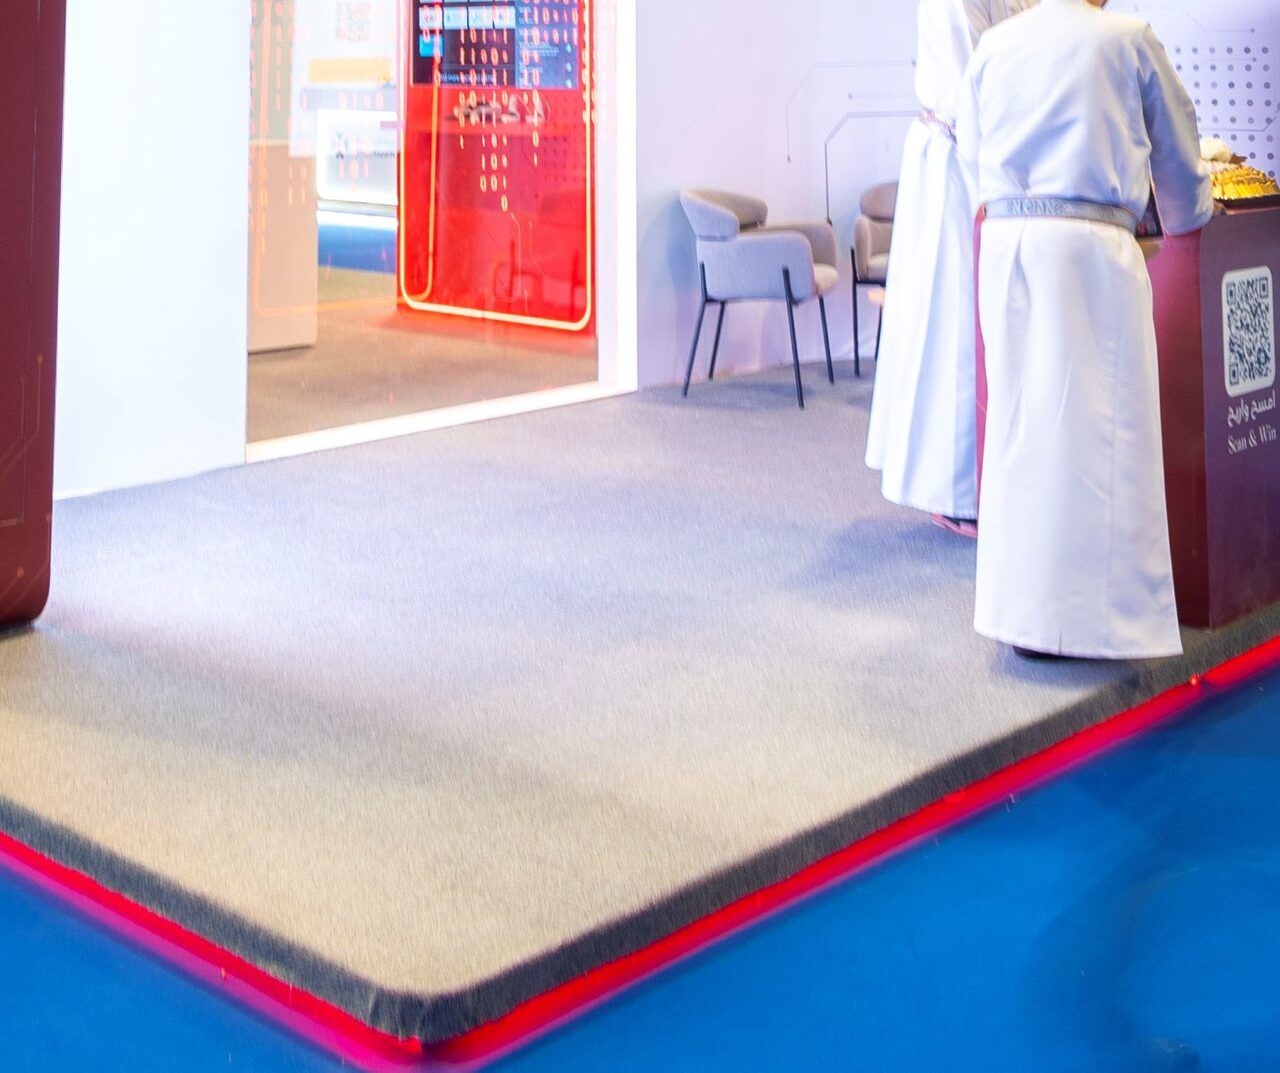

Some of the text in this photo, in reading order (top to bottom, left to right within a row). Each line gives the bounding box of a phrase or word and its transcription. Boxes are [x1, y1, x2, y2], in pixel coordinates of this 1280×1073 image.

[1227, 423, 1277, 455] Scan & Win
